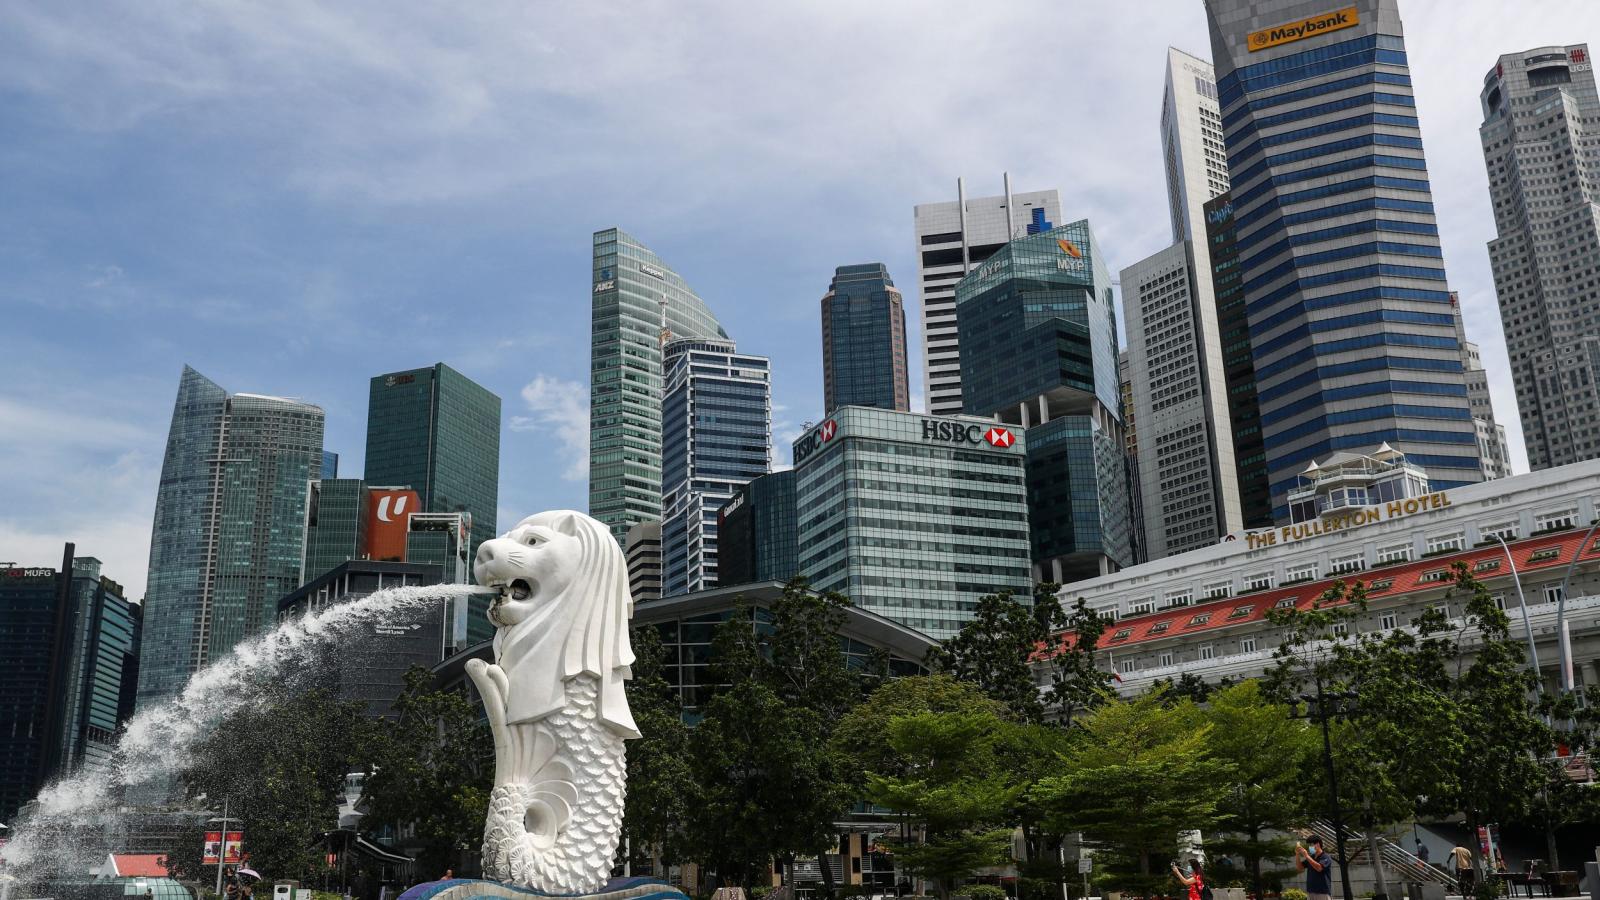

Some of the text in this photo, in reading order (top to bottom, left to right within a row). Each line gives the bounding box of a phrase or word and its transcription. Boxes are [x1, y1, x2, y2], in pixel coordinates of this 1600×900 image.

[1271, 13, 1348, 41] Maybank
[1569, 64, 1592, 73] UOB
[642, 264, 664, 278] Keppel
[980, 261, 1001, 278] MYP
[1057, 258, 1085, 271] MYP
[921, 419, 982, 444] HSBC
[793, 428, 820, 463] HSBC
[1245, 491, 1452, 550] THE FULLERTON HOTEL
[24, 569, 51, 577] MUFG
